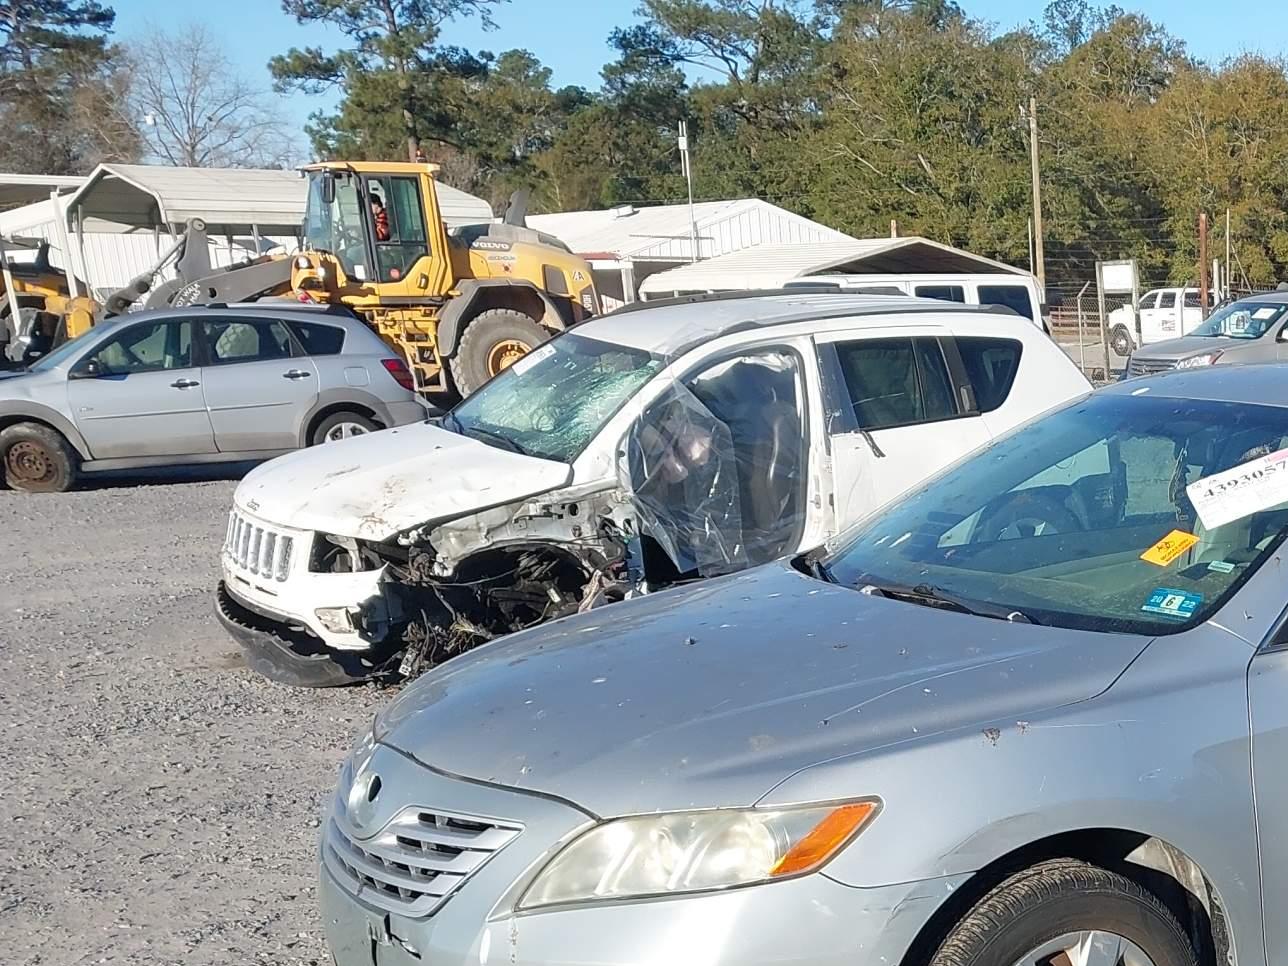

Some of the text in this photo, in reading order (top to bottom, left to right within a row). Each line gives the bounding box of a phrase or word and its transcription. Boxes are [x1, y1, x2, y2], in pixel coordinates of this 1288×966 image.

[472, 241, 510, 249] VOLVO
[1150, 595, 1196, 609] 20 6 22
